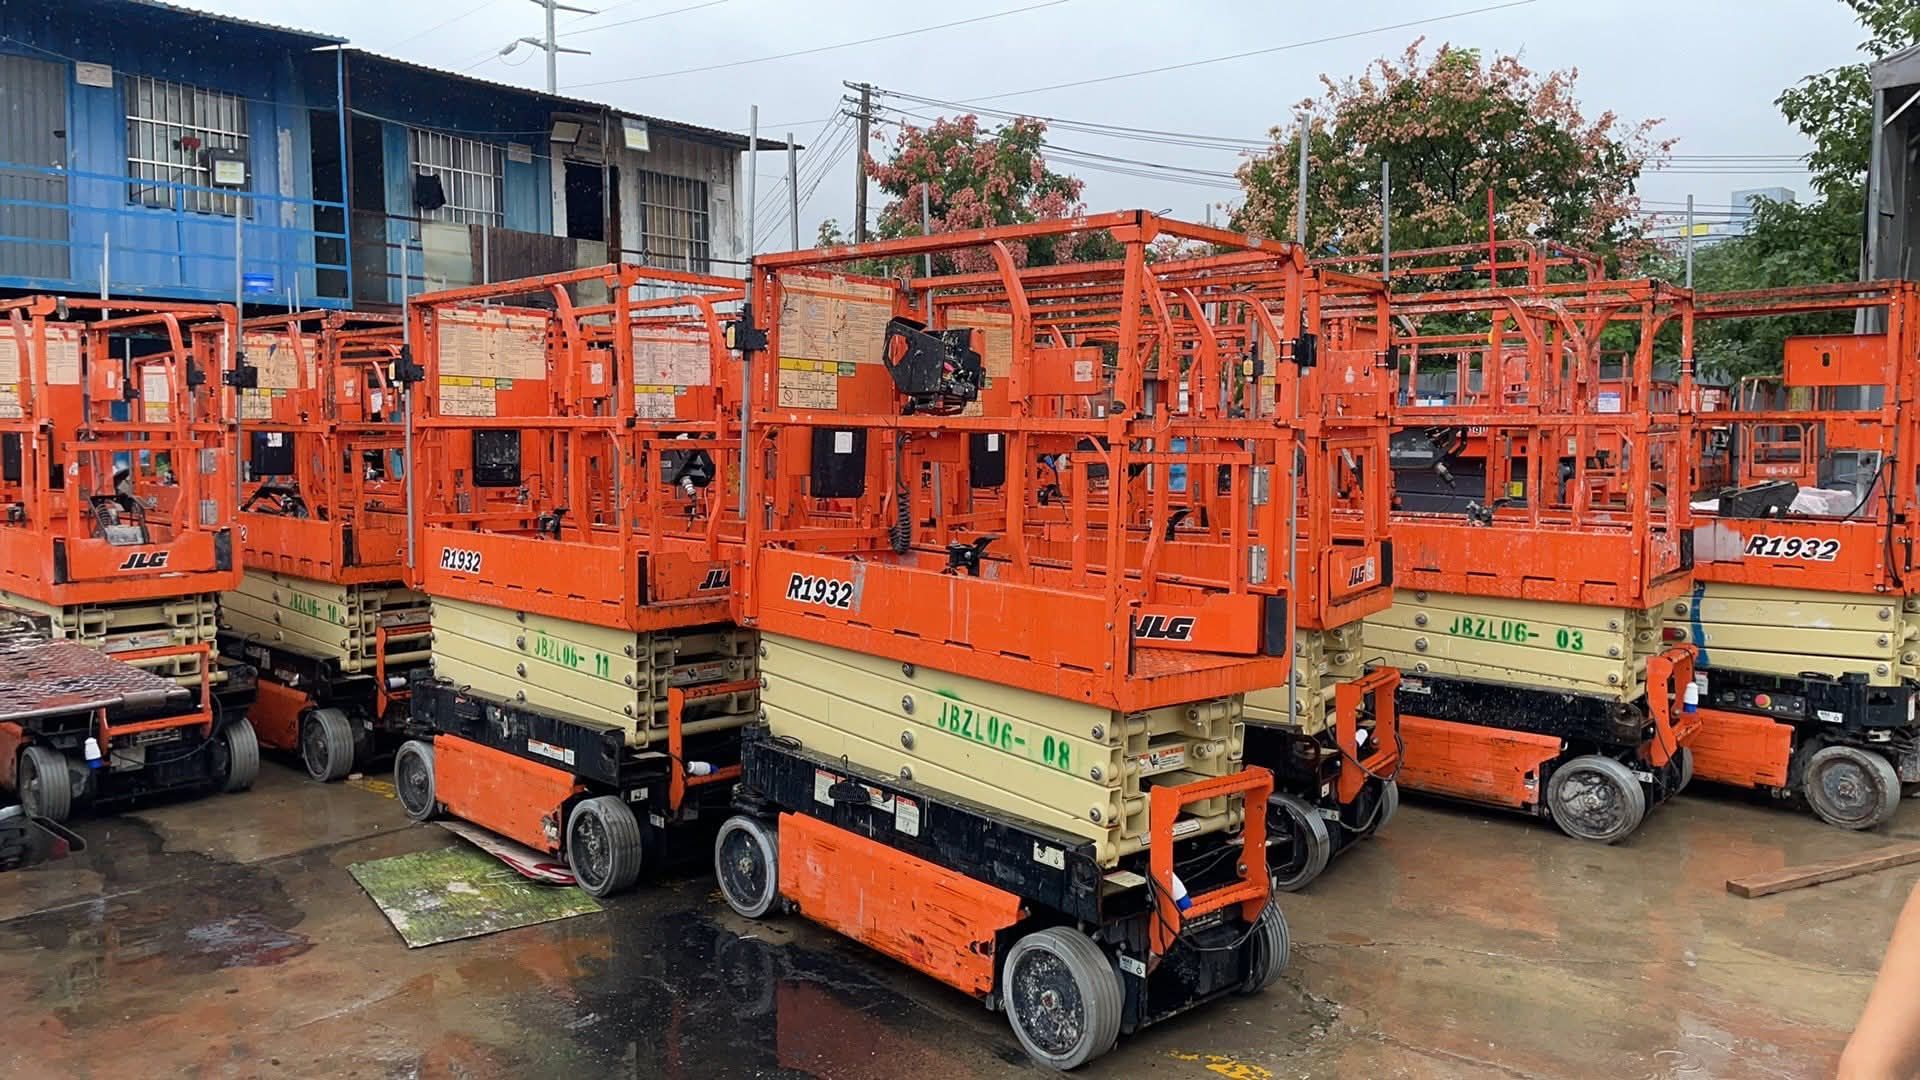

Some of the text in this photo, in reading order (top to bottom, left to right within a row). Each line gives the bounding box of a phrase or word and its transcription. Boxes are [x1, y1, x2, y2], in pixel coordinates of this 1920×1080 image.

[118, 550, 169, 570] JLG
[440, 546, 482, 575] R1932
[1744, 534, 1841, 562] R1932
[1347, 563, 1366, 589] JLG
[785, 572, 854, 610] R1932
[1136, 614, 1197, 642] JLG
[1043, 735, 1070, 770] 08
